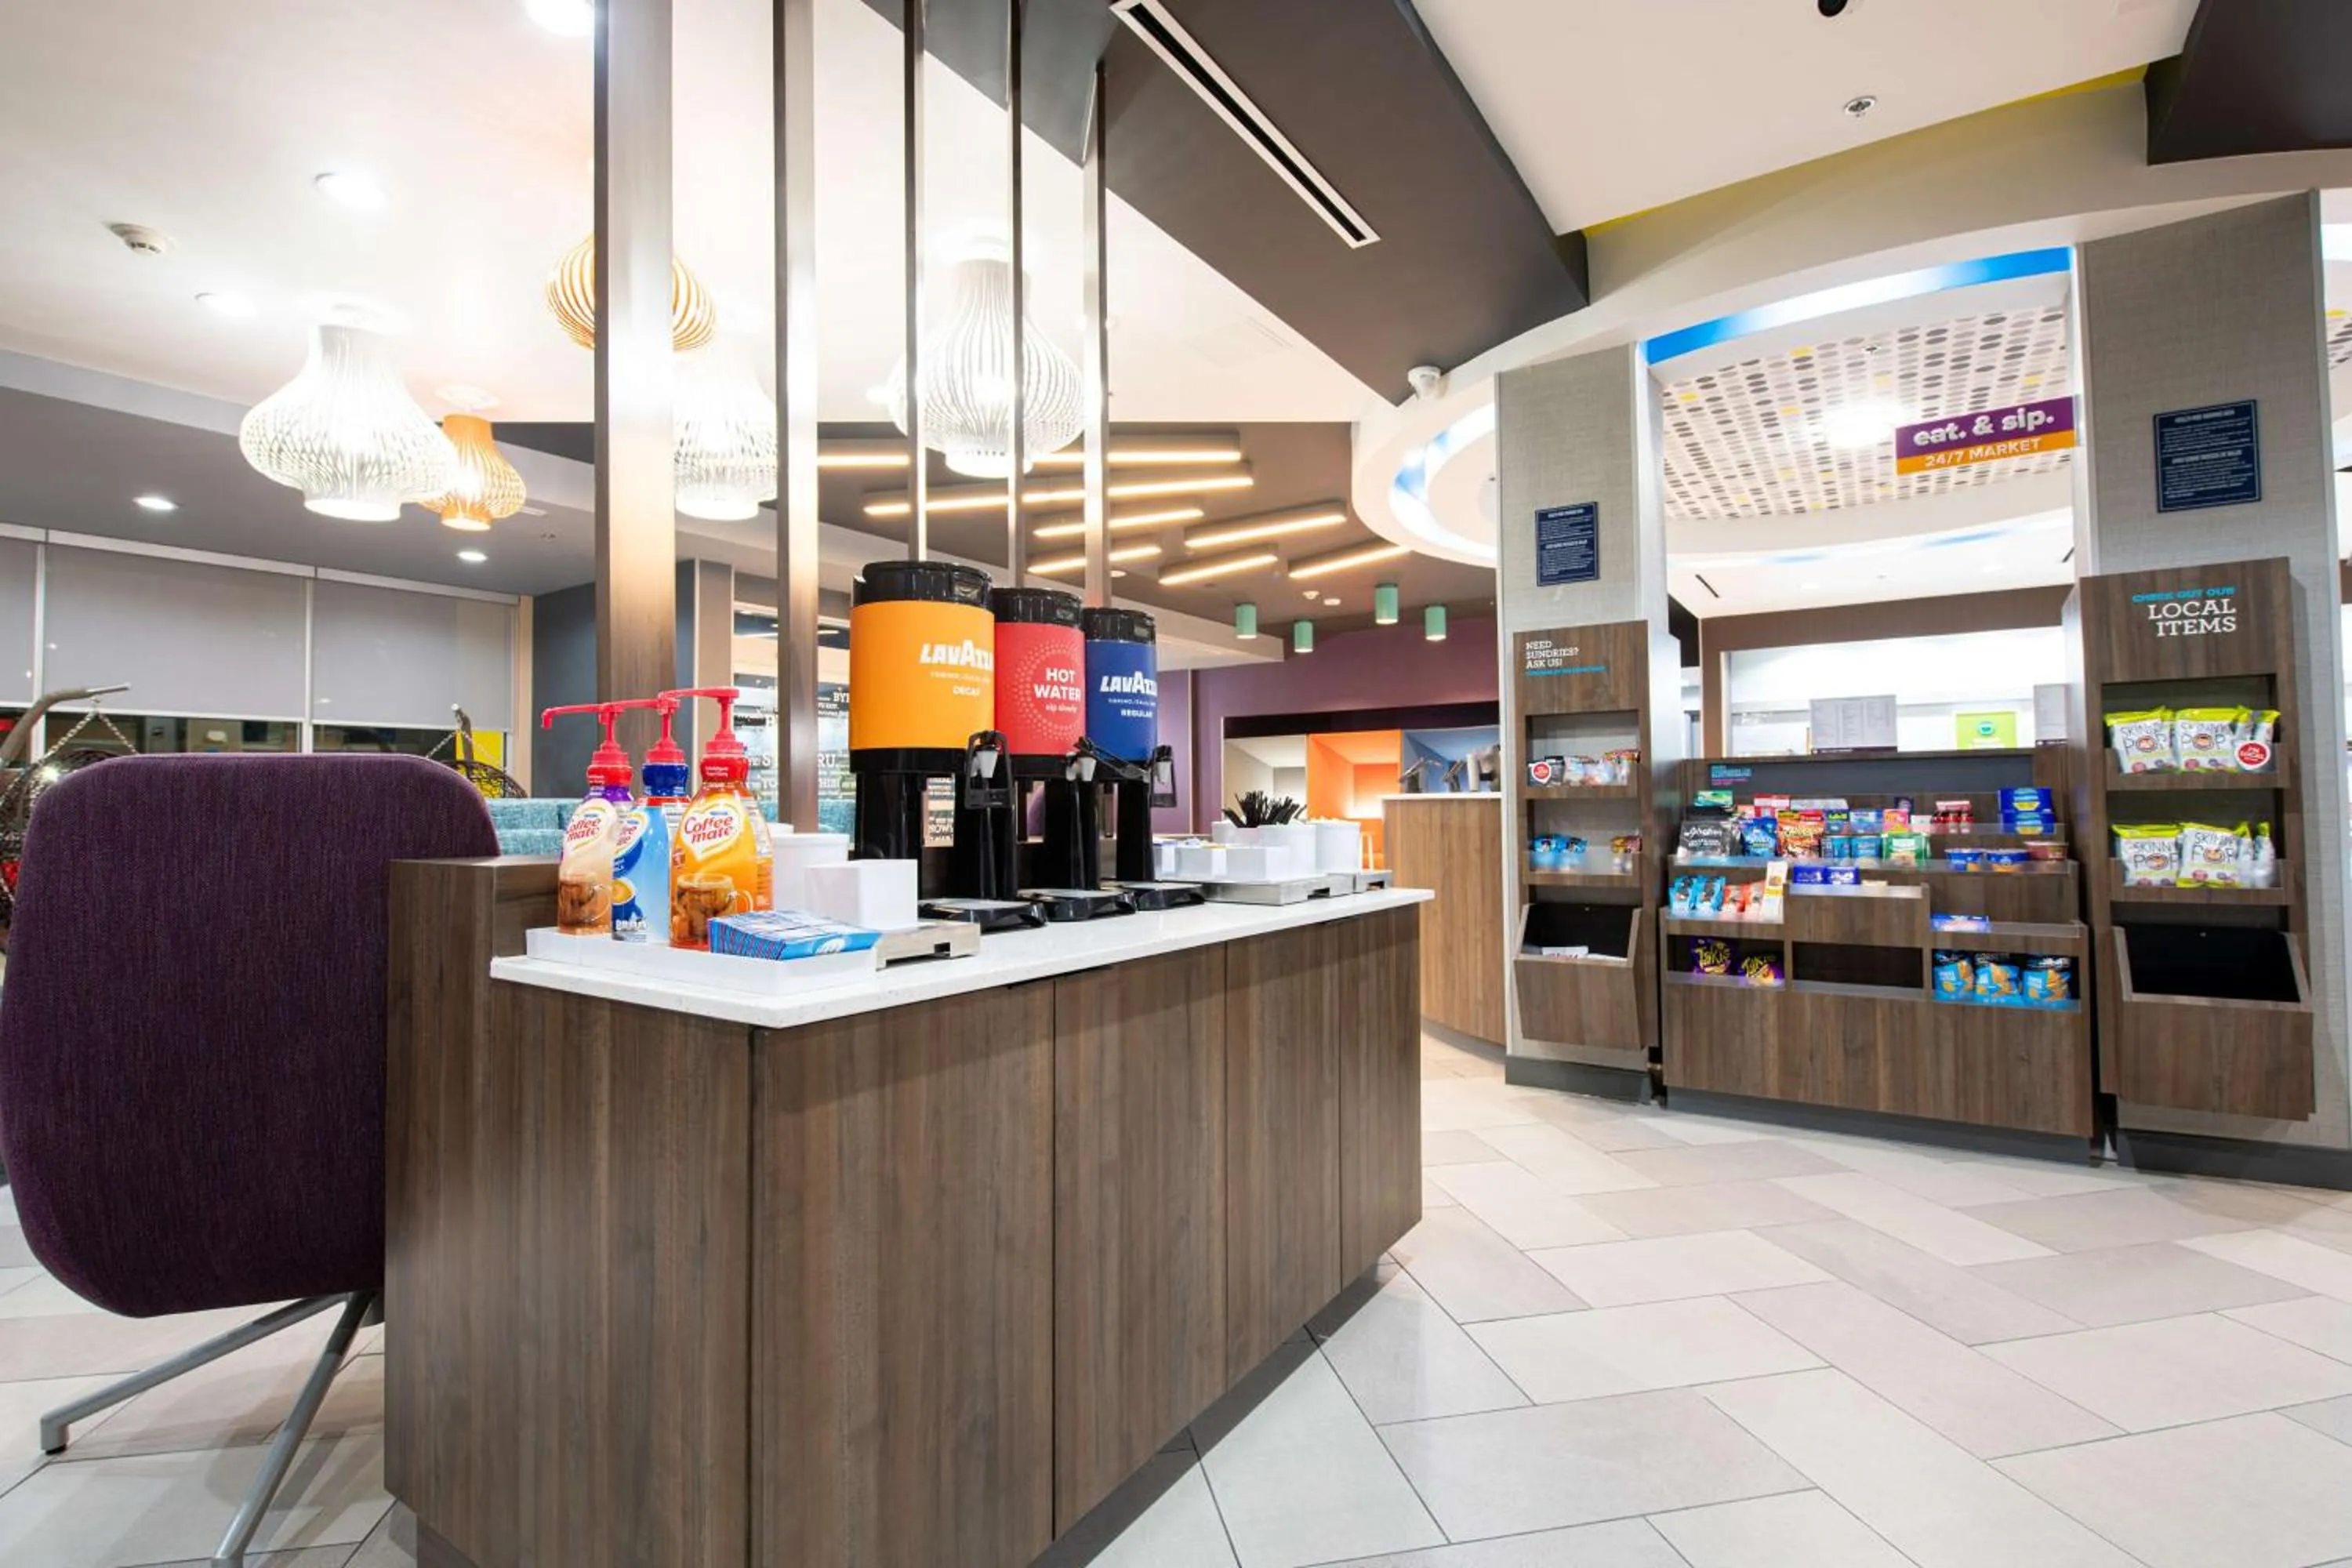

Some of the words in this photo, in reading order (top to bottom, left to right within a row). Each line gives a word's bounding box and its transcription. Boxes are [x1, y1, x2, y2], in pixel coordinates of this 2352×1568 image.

[1913, 423, 1966, 446] eat.
[1972, 415, 1994, 436] &
[2002, 407, 2054, 431] sip.
[1925, 449, 1965, 466] 24/7
[1969, 437, 2042, 460] MARKET
[2147, 598, 2236, 619] LOCAL
[2155, 616, 2236, 637] ITEMS
[1526, 640, 1552, 650] NEED
[920, 639, 993, 672] LAVAZZ
[1526, 659, 1546, 670] ASK
[1045, 667, 1076, 684] HOT
[1099, 670, 1158, 697] LAVAZZ
[1033, 683, 1081, 702] WATER
[684, 815, 733, 835] Coffee
[691, 826, 733, 844] mate
